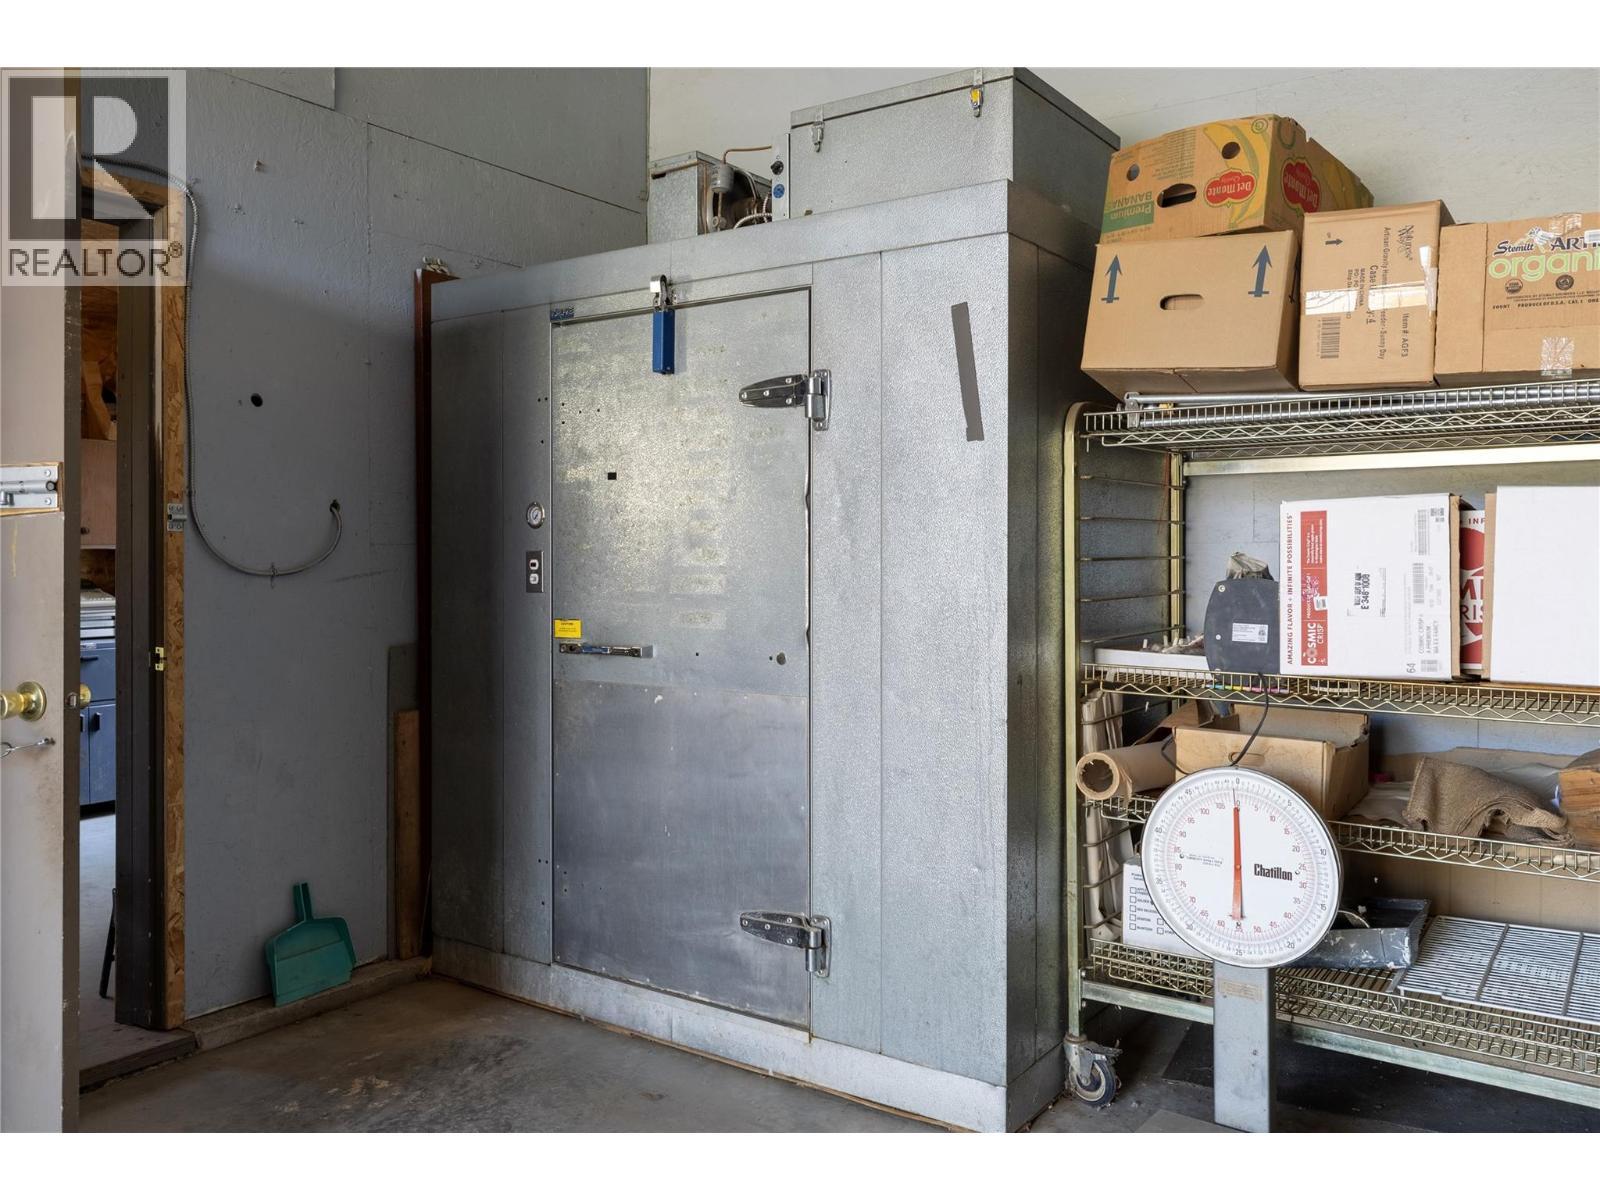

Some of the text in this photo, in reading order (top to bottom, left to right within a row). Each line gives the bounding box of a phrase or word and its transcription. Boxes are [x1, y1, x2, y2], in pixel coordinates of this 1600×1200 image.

[1207, 180, 1252, 196] Monte Del
[1284, 174, 1307, 200] Monte
[1110, 203, 1152, 220] Premium
[1494, 240, 1534, 255] Stemilt
[1381, 248, 1390, 268] Gravity
[1370, 265, 1378, 283] Case
[1378, 330, 1387, 348] Sunny
[1378, 348, 1386, 360] Day
[1308, 622, 1316, 664] COSMIC
[1406, 663, 1416, 674] 64
[1254, 864, 1293, 881] Chatillon
